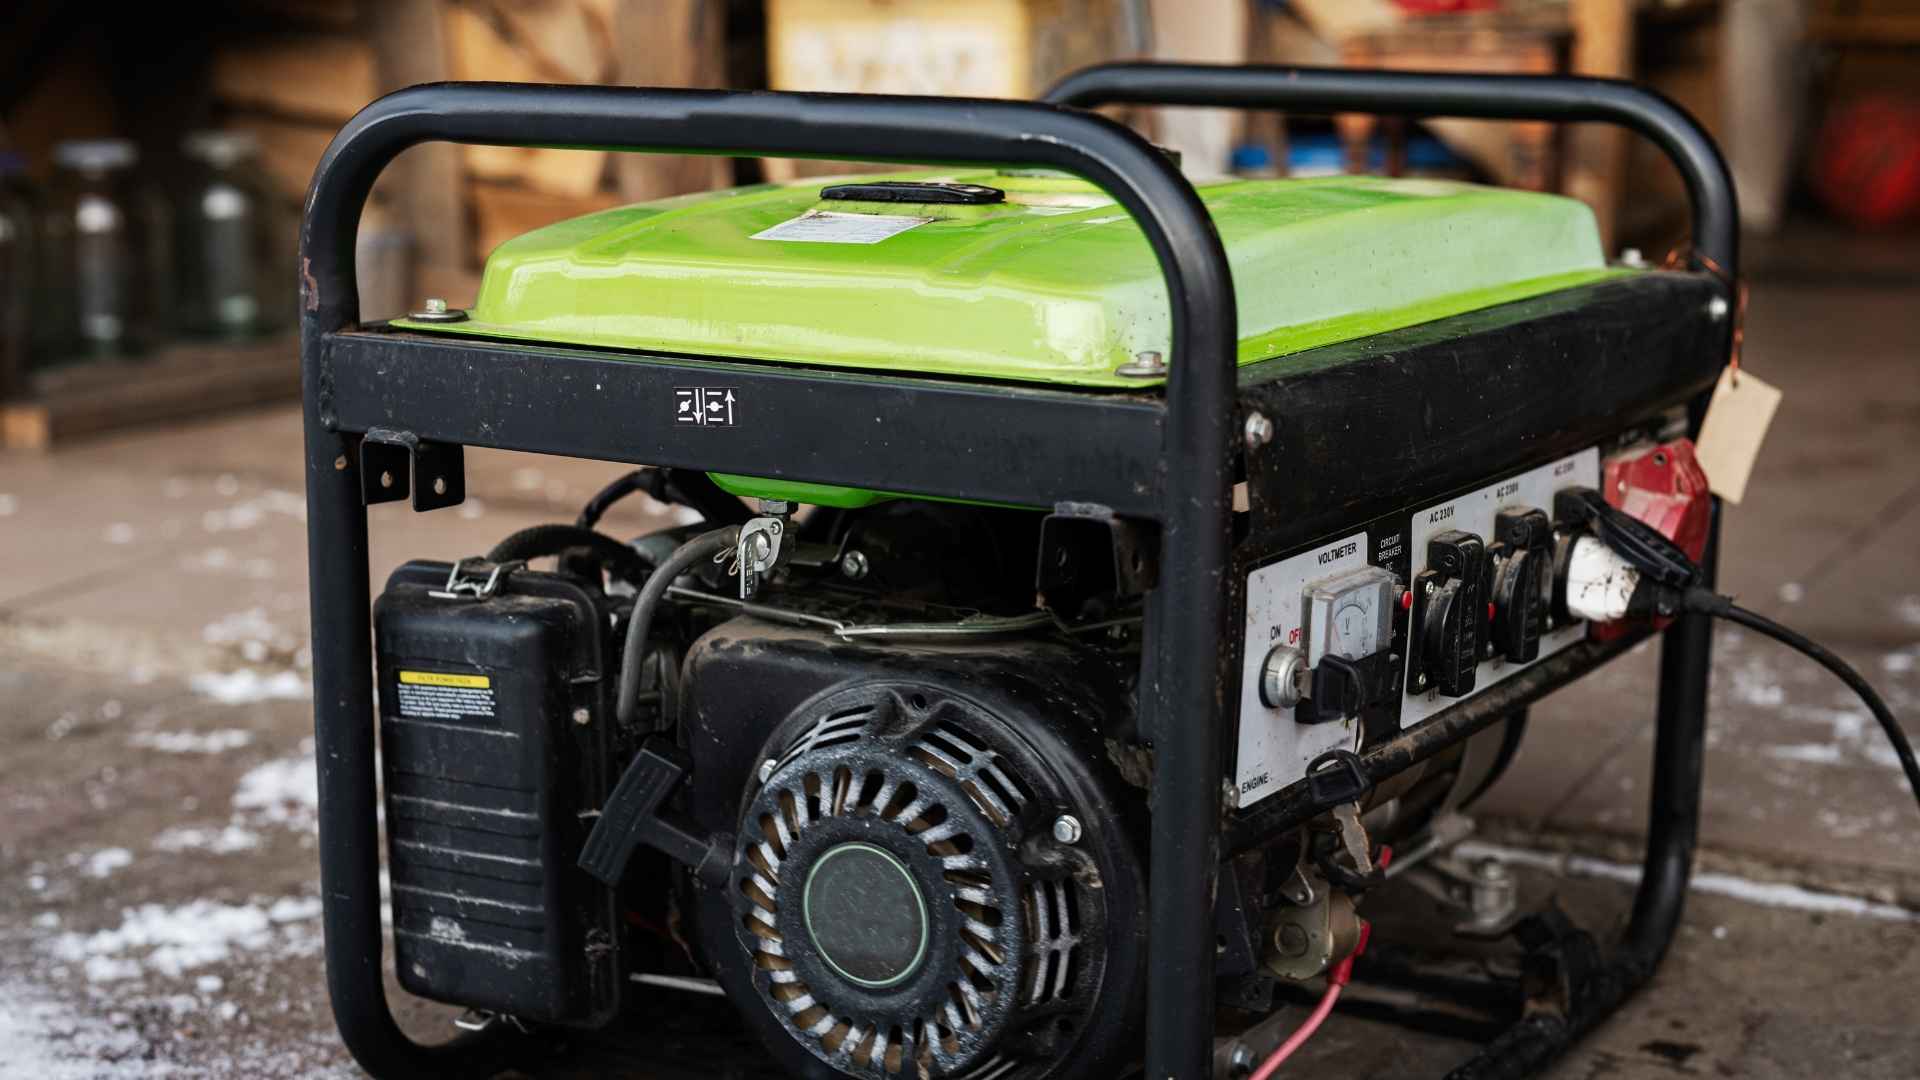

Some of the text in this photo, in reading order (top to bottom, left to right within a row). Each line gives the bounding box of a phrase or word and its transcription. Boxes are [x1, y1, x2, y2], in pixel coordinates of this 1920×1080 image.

[1496, 482, 1519, 498] AC 230V
[1429, 505, 1455, 525] AC 230V
[1380, 534, 1399, 549] CIRCUIT
[1318, 542, 1357, 565] VOLTMETER
[1379, 545, 1402, 561] BREAKER
[1270, 624, 1281, 640] ON
[1241, 772, 1269, 794] ENGINE
